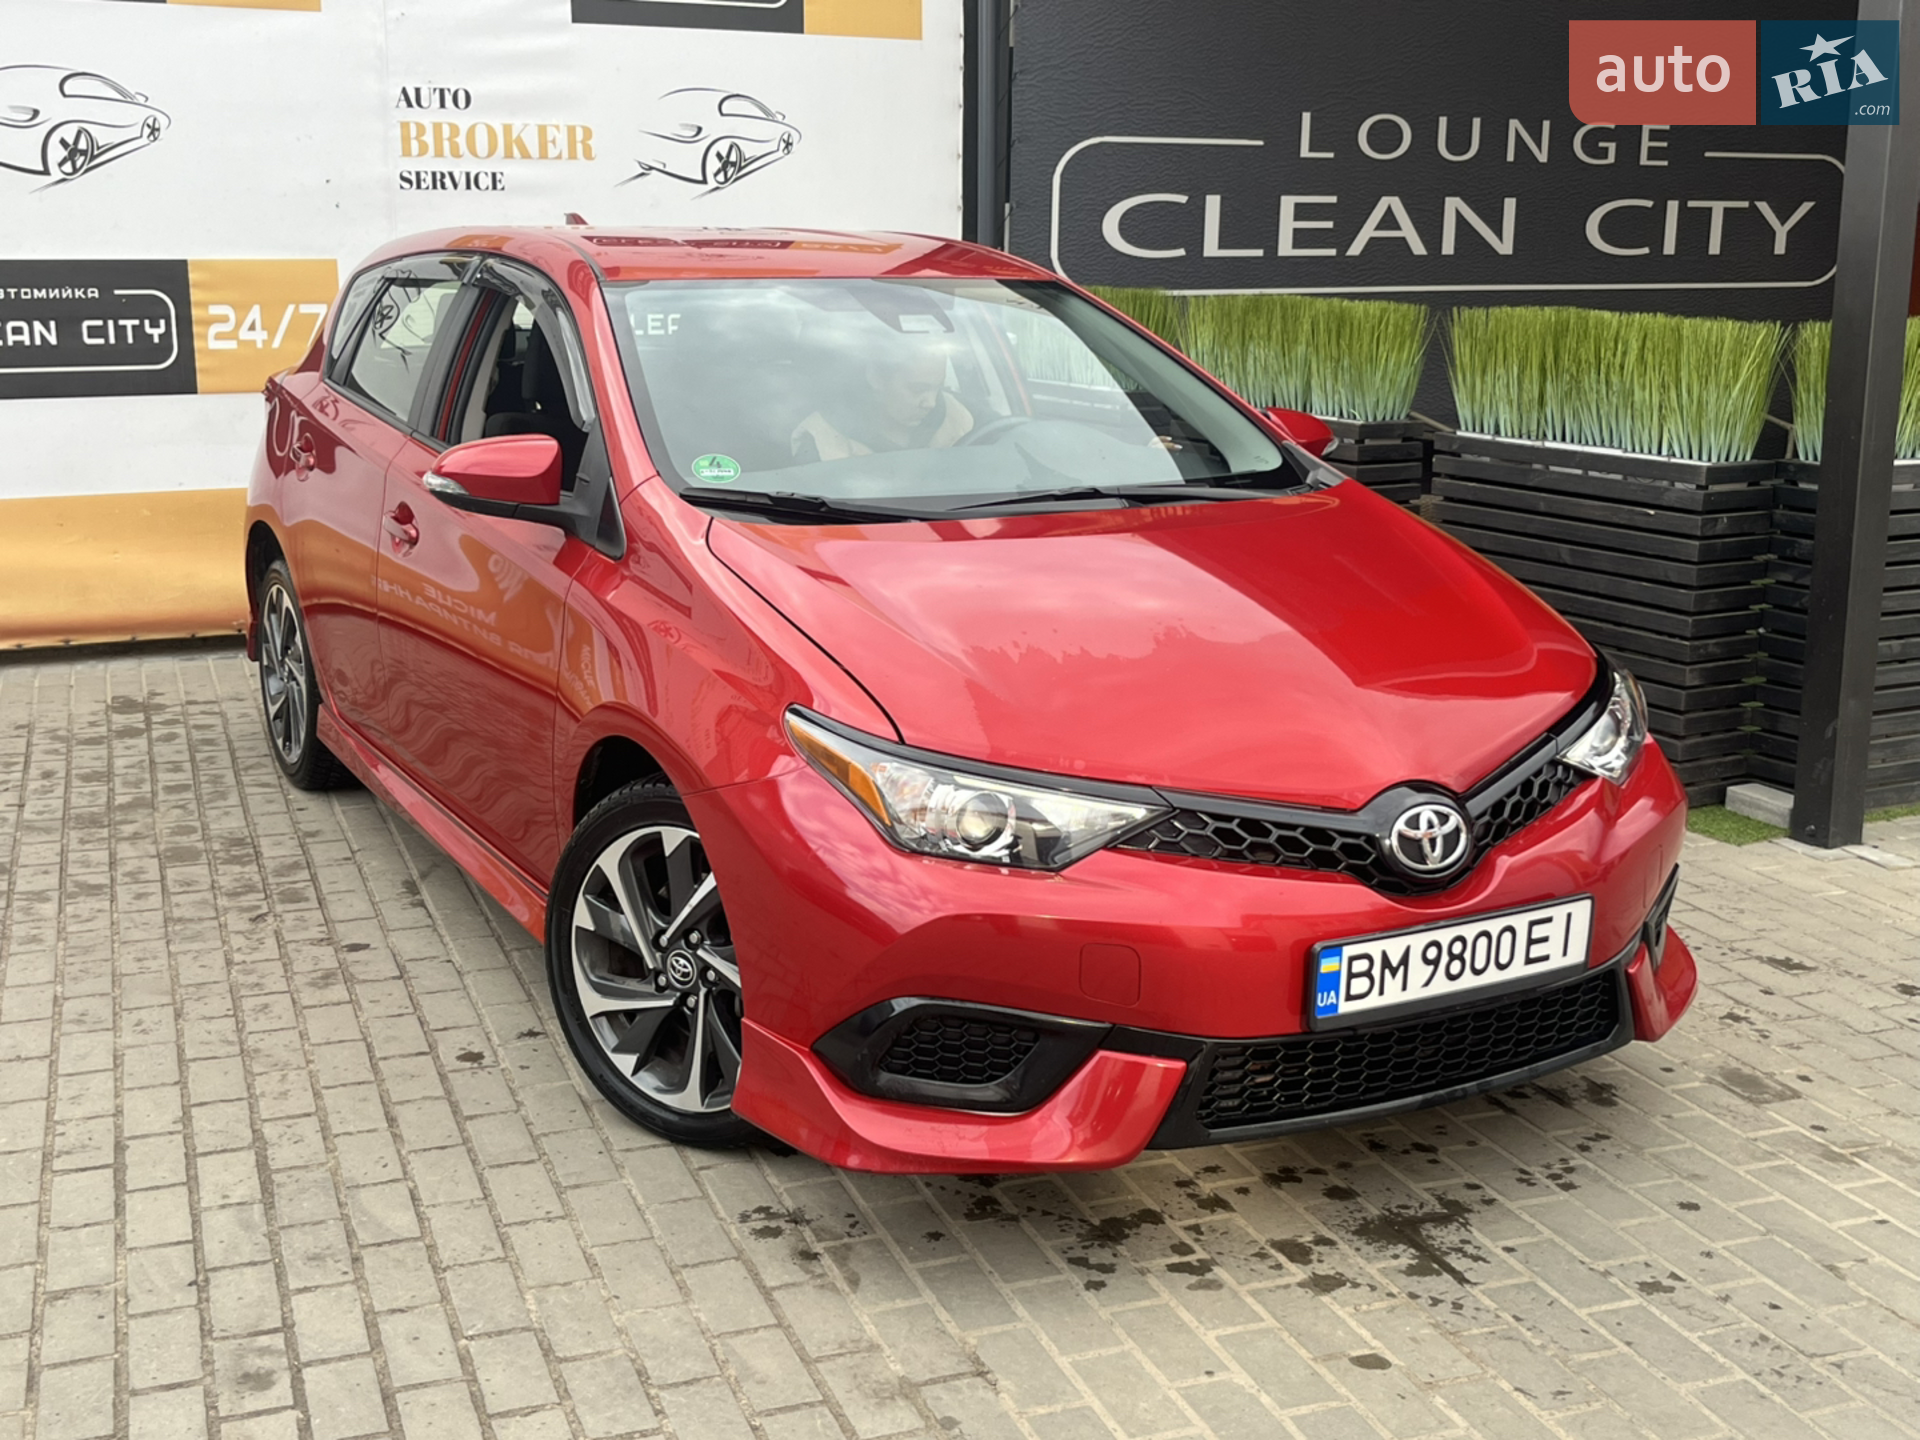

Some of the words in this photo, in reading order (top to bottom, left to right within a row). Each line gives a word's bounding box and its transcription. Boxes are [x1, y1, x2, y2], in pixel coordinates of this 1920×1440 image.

[395, 86, 472, 111] AUTO
[398, 120, 597, 161] BROKER
[1300, 111, 1670, 166] LOUNGE
[399, 170, 506, 191] SERVICE
[1102, 193, 1517, 258] CLEAN
[1585, 198, 1817, 256] CITY
[0, 320, 58, 346] AN
[82, 319, 166, 345] CITY
[207, 303, 329, 350] 24/7
[1316, 990, 1338, 1007] UA
